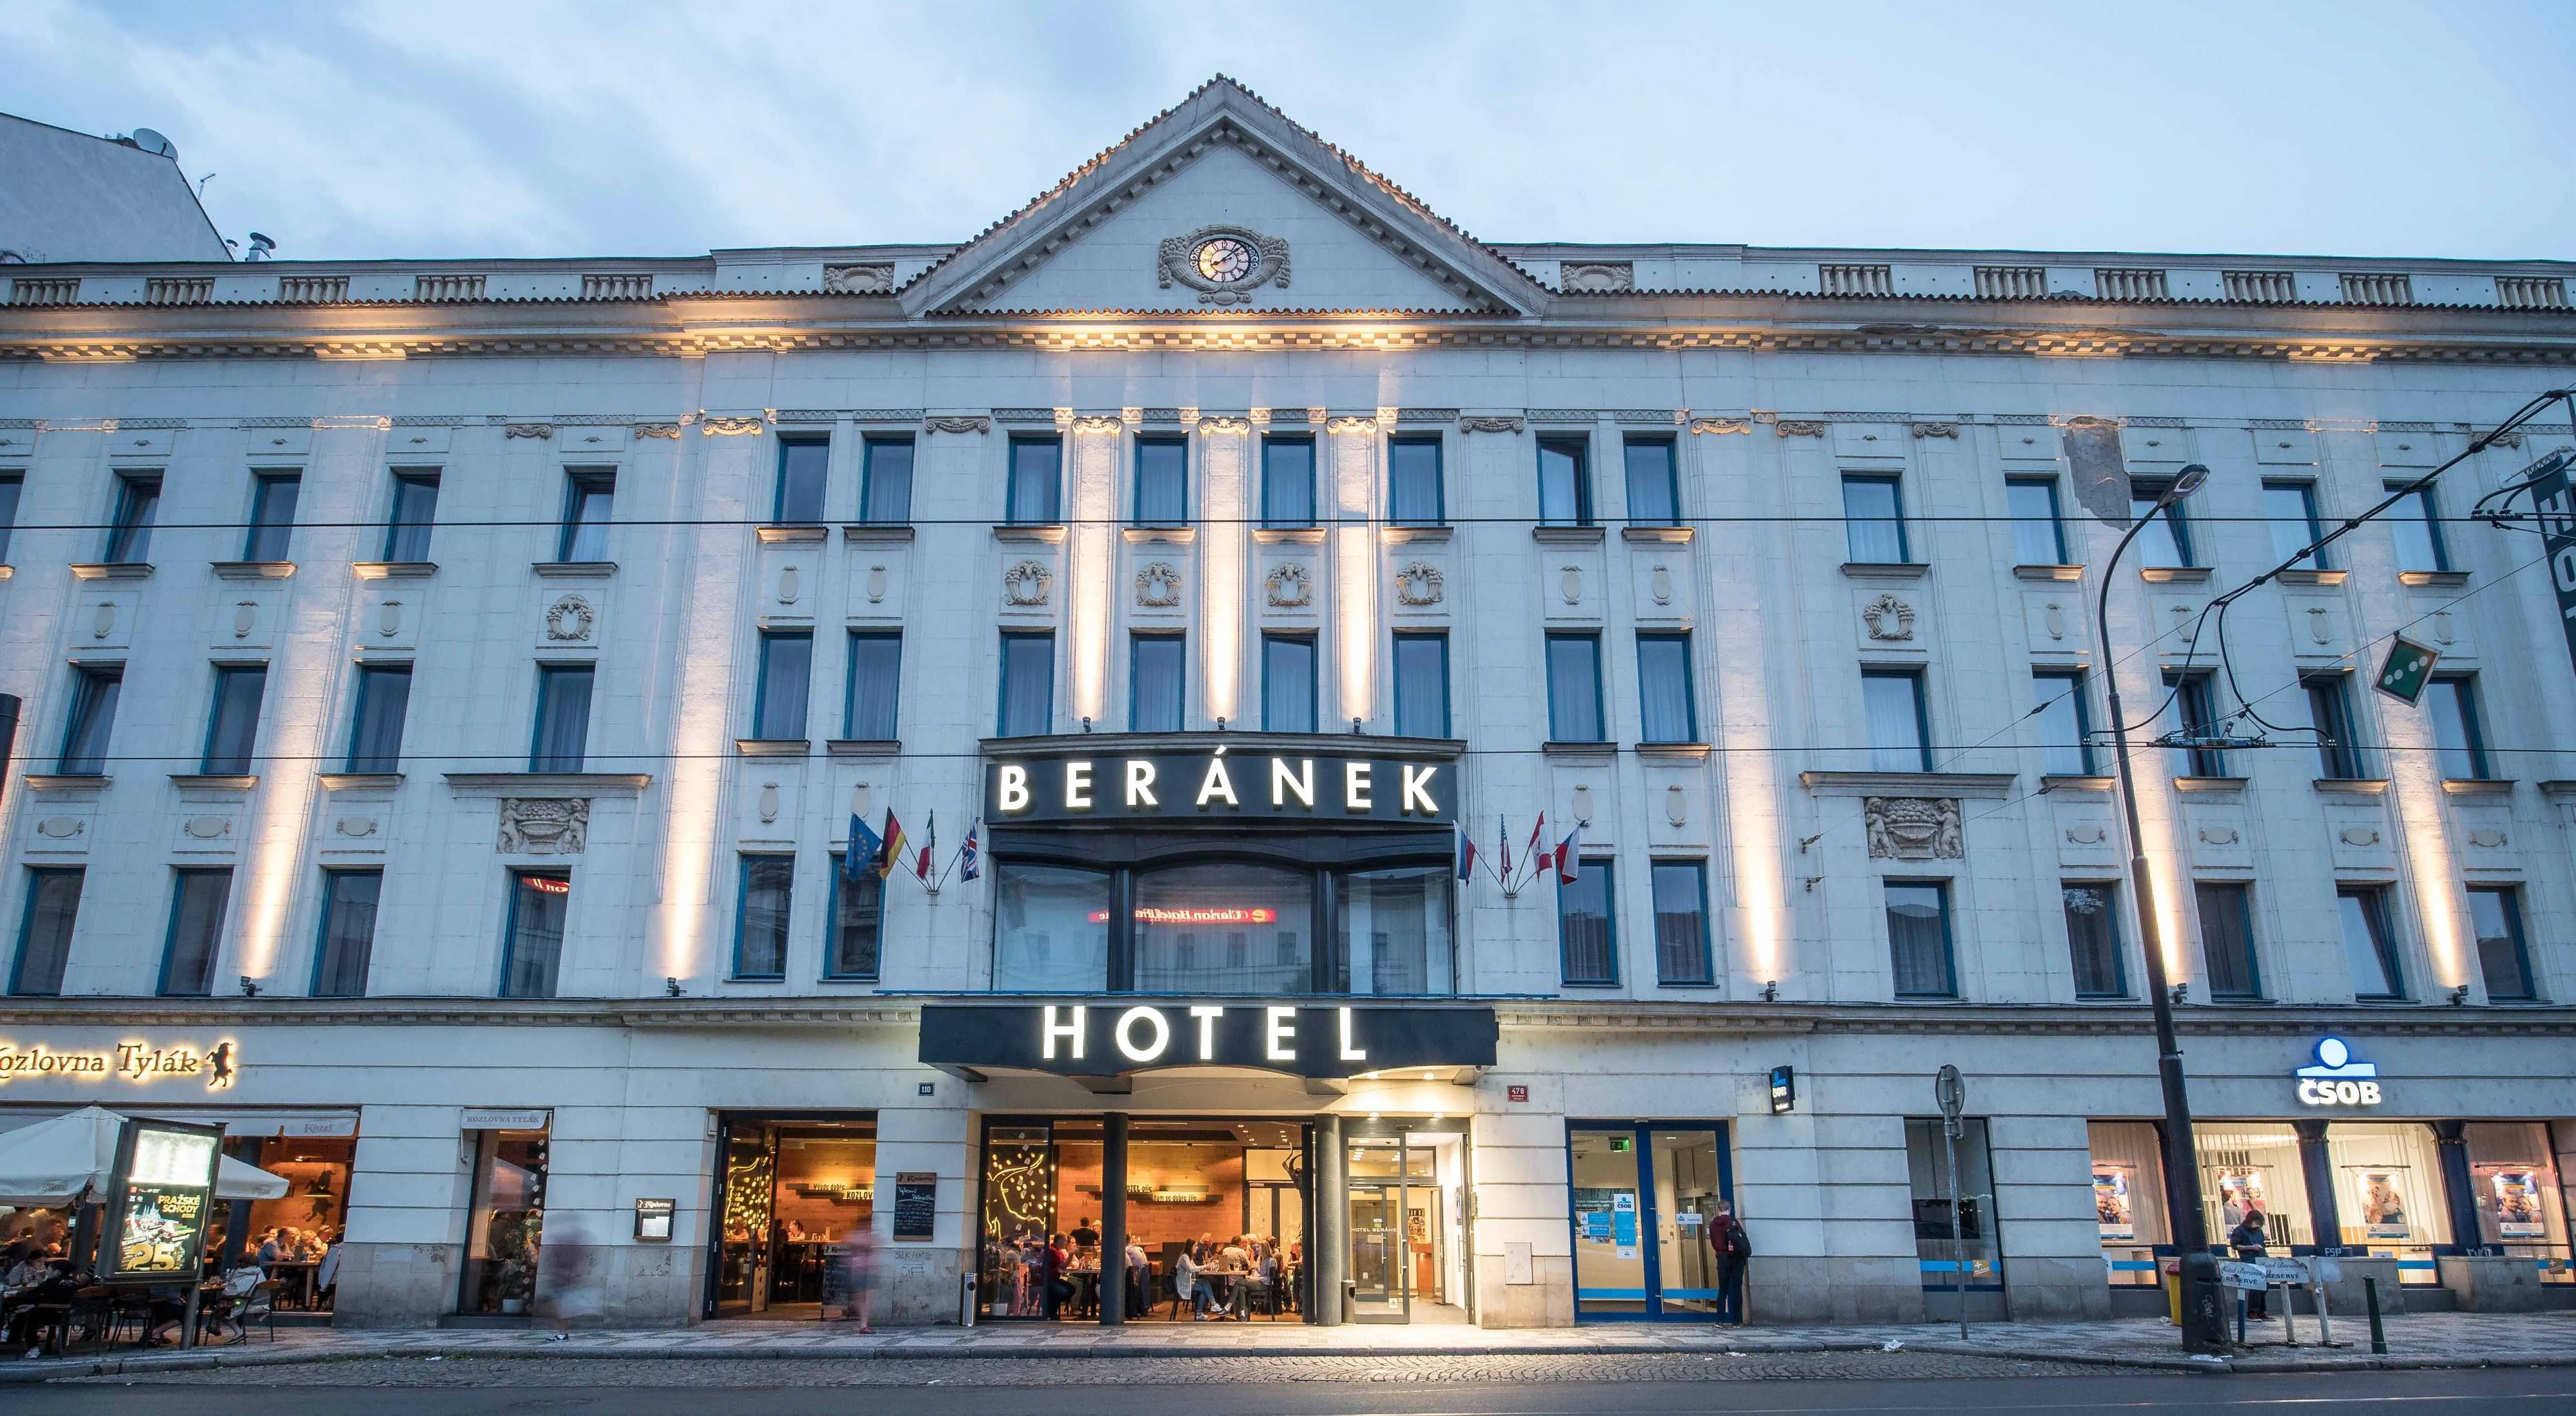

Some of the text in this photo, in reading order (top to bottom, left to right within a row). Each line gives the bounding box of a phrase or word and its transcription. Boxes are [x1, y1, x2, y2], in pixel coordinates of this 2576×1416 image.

[999, 745, 1440, 814] BERÁNEK
[1043, 1005, 1366, 1061] HOTEL
[117, 1043, 198, 1079] Tylák
[2299, 1078, 2382, 1105] ČSOB
[157, 1194, 201, 1205] PRAŽSKÉ
[162, 1204, 199, 1214] SCHODY
[847, 1191, 874, 1200] KOZLOV
